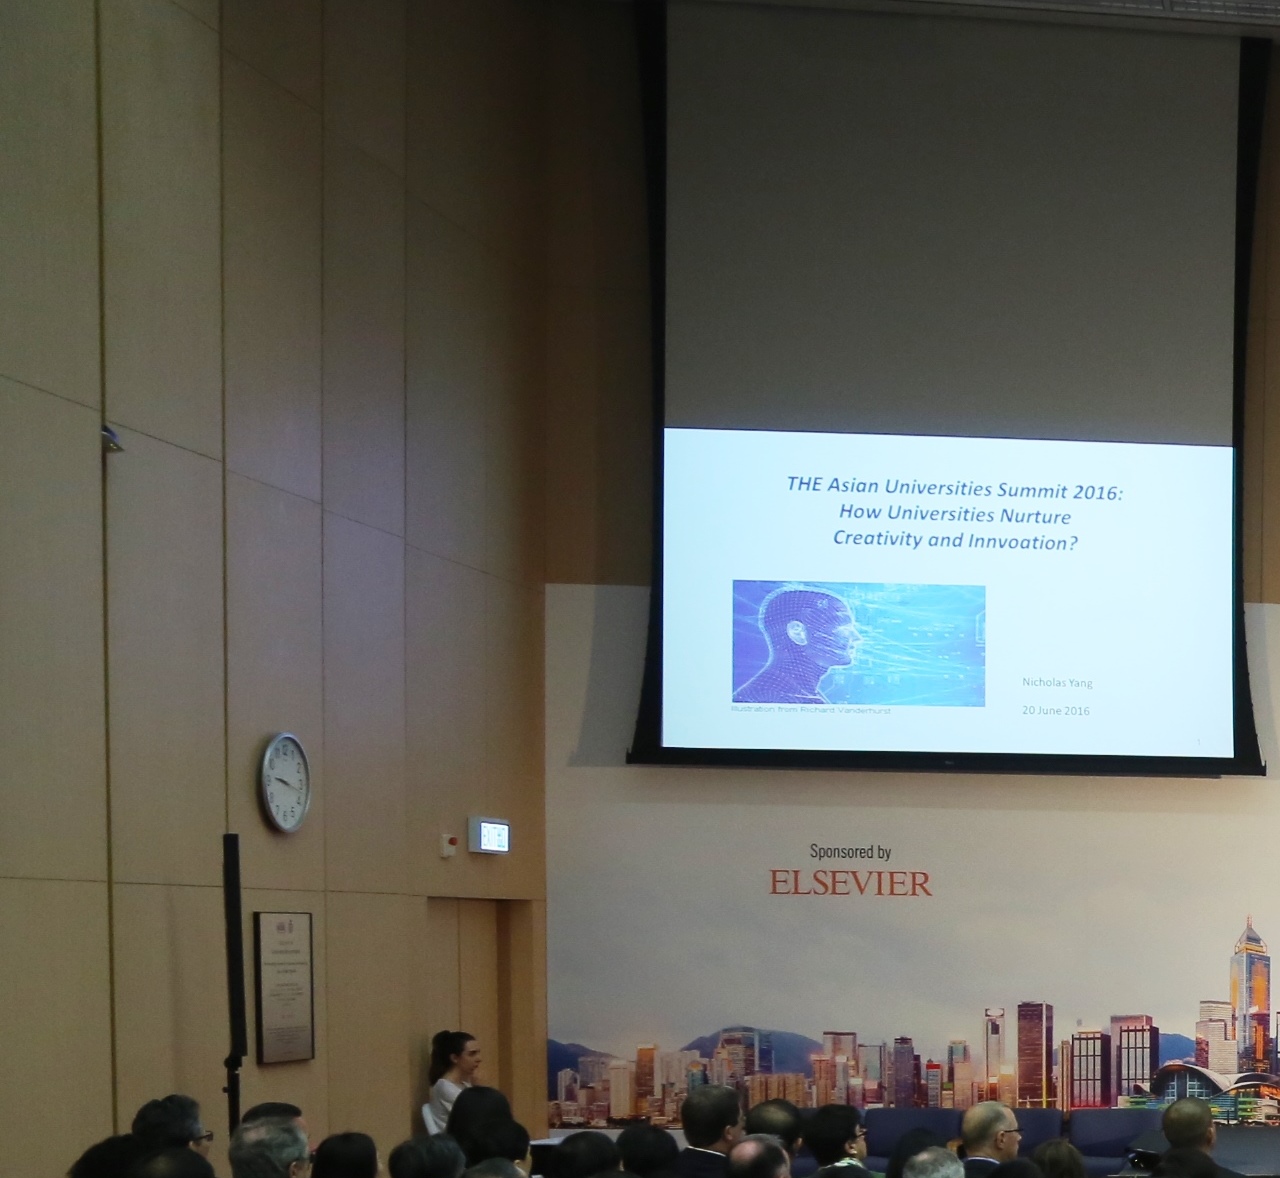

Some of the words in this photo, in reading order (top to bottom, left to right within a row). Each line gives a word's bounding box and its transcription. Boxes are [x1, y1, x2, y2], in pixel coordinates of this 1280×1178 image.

[787, 475, 824, 492] THE
[827, 477, 879, 494] Asian
[885, 478, 992, 497] Universities
[997, 482, 1068, 499] Summit
[1072, 484, 1124, 501] 2016:
[839, 503, 882, 520] How
[887, 504, 995, 523] Universities
[1000, 508, 1072, 525] Nurture
[833, 529, 923, 550] Creativity
[928, 532, 964, 548] and
[968, 533, 1079, 551] Innvoation?
[1022, 676, 1067, 688] Nicholas
[1068, 678, 1094, 690] Yang
[1022, 705, 1036, 716] 20
[1037, 706, 1063, 716] June
[1064, 706, 1091, 716] 2016
[810, 843, 874, 861] Sponsored
[877, 844, 892, 862] by
[769, 869, 934, 897] ELSEVIER
